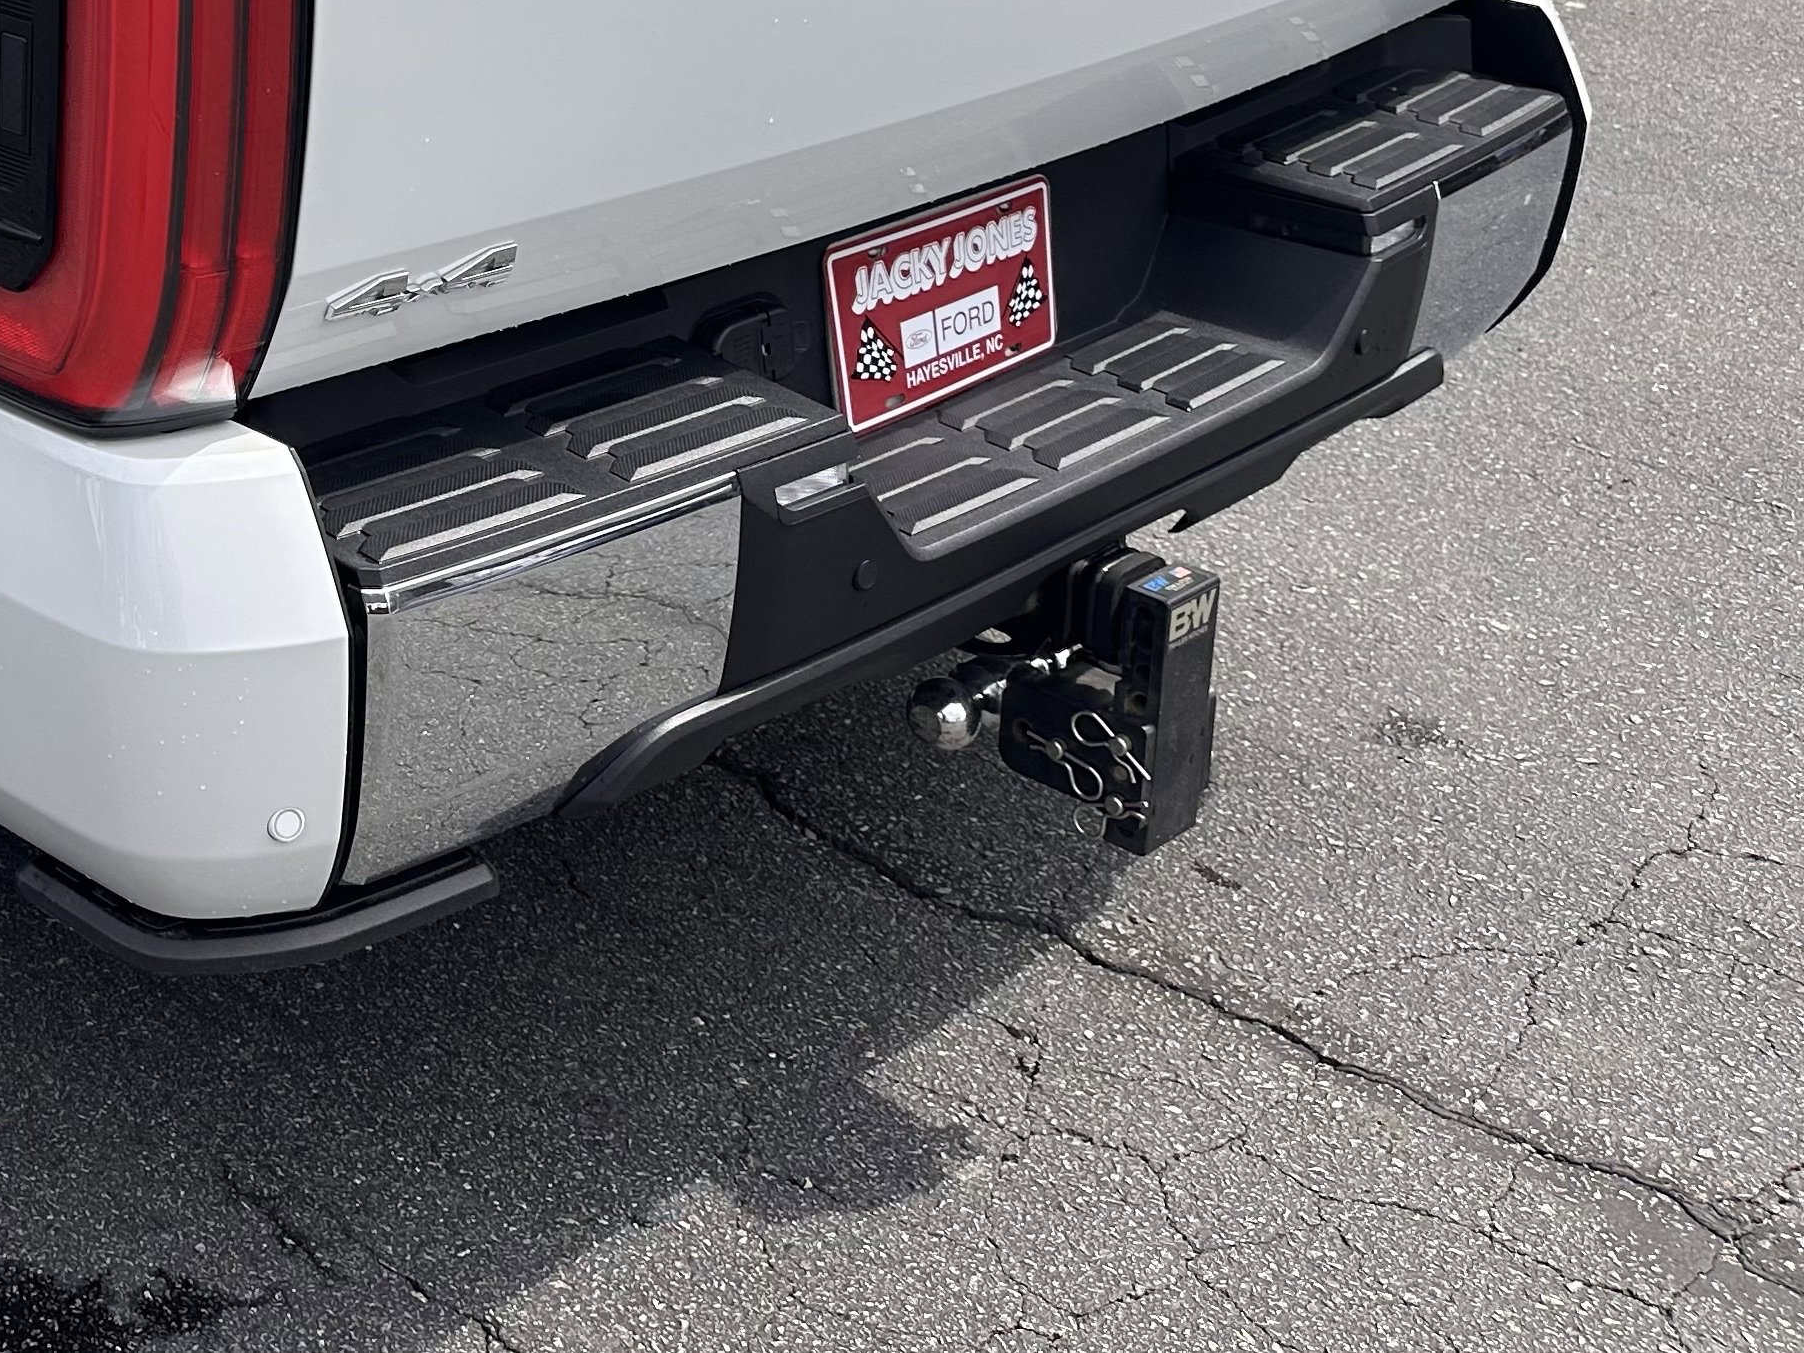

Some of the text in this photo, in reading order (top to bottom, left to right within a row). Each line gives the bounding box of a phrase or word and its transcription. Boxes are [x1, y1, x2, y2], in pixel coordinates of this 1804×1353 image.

[851, 206, 1038, 315] JACKY JONES
[941, 300, 995, 341] FORD
[906, 334, 1004, 388] HAYESVILLE, NC
